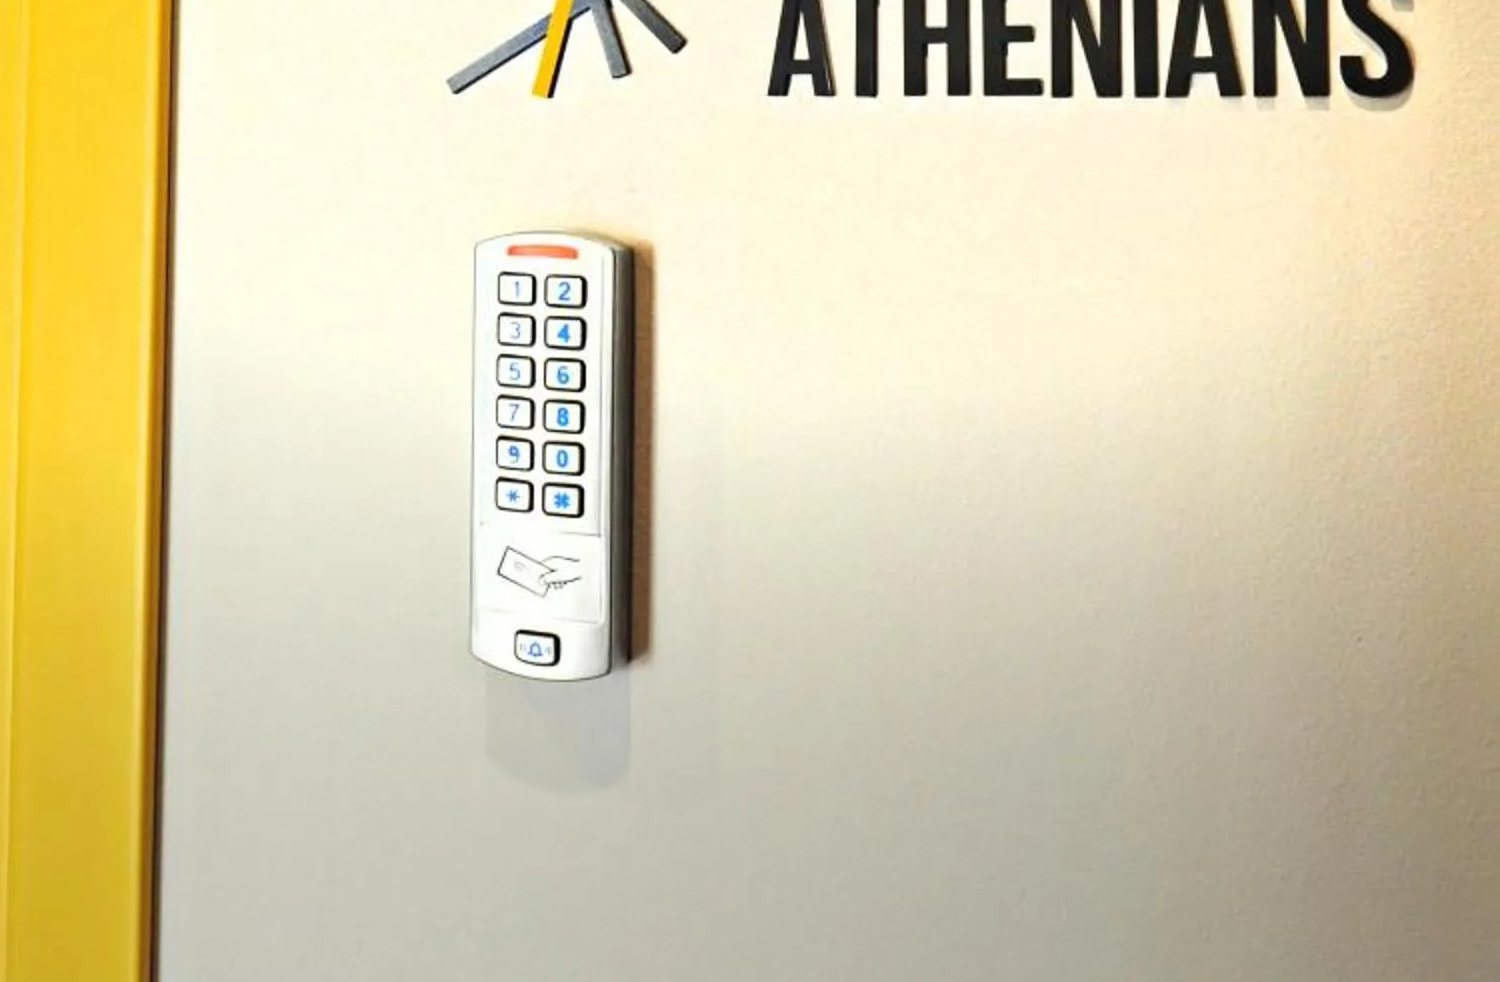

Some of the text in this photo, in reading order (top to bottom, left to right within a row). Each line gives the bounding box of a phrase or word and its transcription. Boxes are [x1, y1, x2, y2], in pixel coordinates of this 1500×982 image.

[513, 281, 571, 301] 1 2
[510, 321, 571, 343] 3 4
[509, 362, 570, 384] 5 6
[508, 403, 569, 426] 7 8
[508, 445, 569, 468] 9 0
